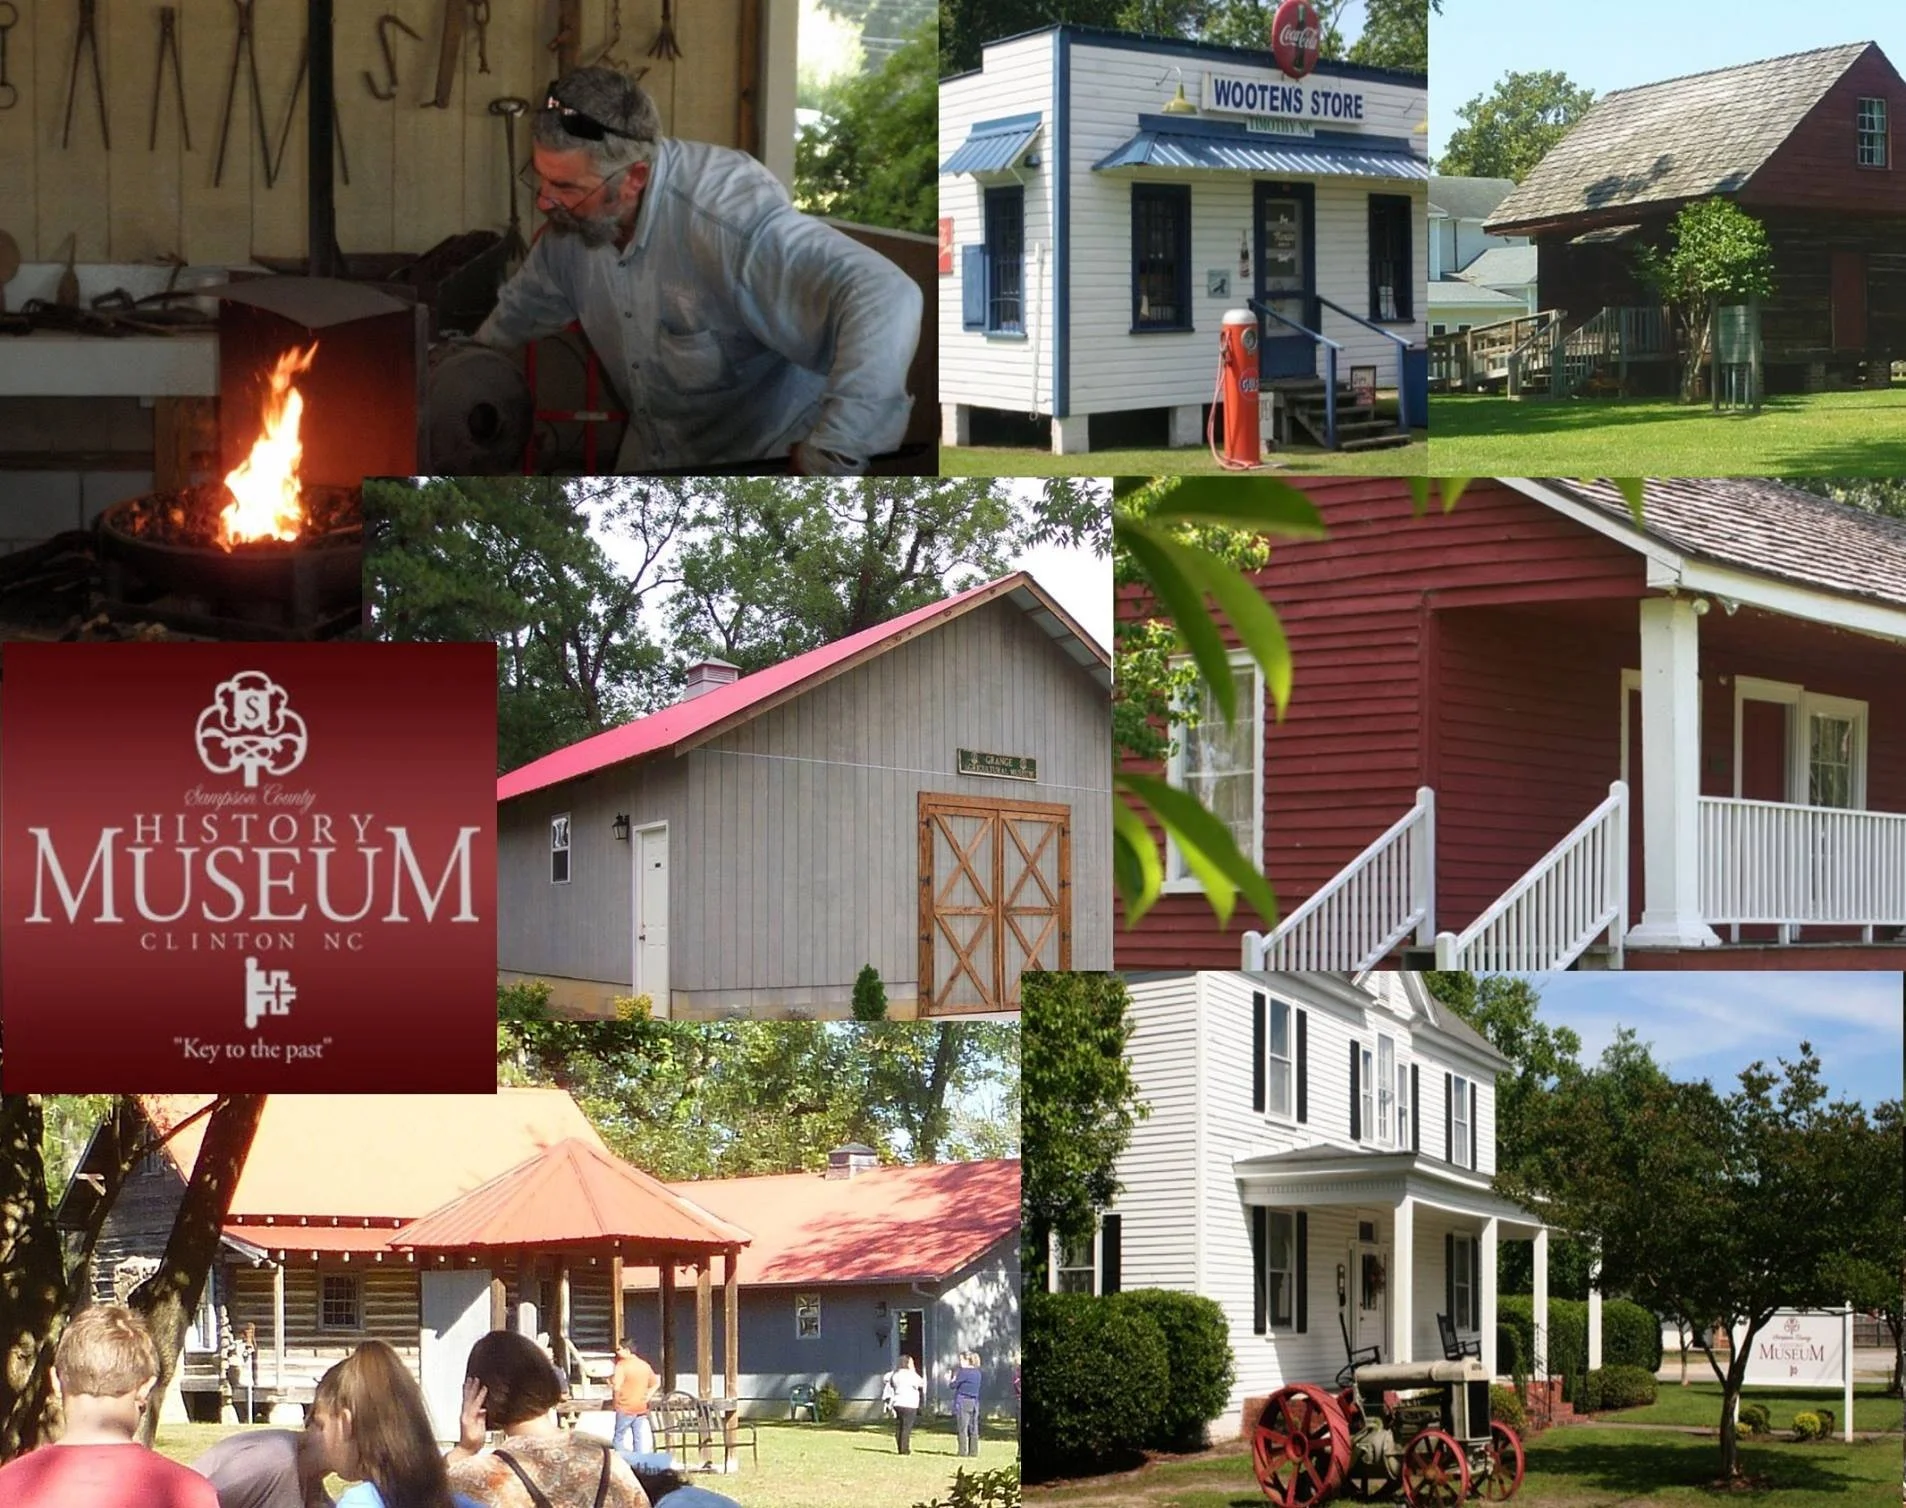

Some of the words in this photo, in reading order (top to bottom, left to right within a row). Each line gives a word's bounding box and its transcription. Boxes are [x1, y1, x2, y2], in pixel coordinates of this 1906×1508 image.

[1311, 90, 1364, 119] STORE
[1250, 117, 1296, 134] TIMOTHY
[1299, 120, 1314, 135] NC
[985, 755, 1014, 767] GRANGE
[1759, 1343, 1825, 1362] MUSEUM
